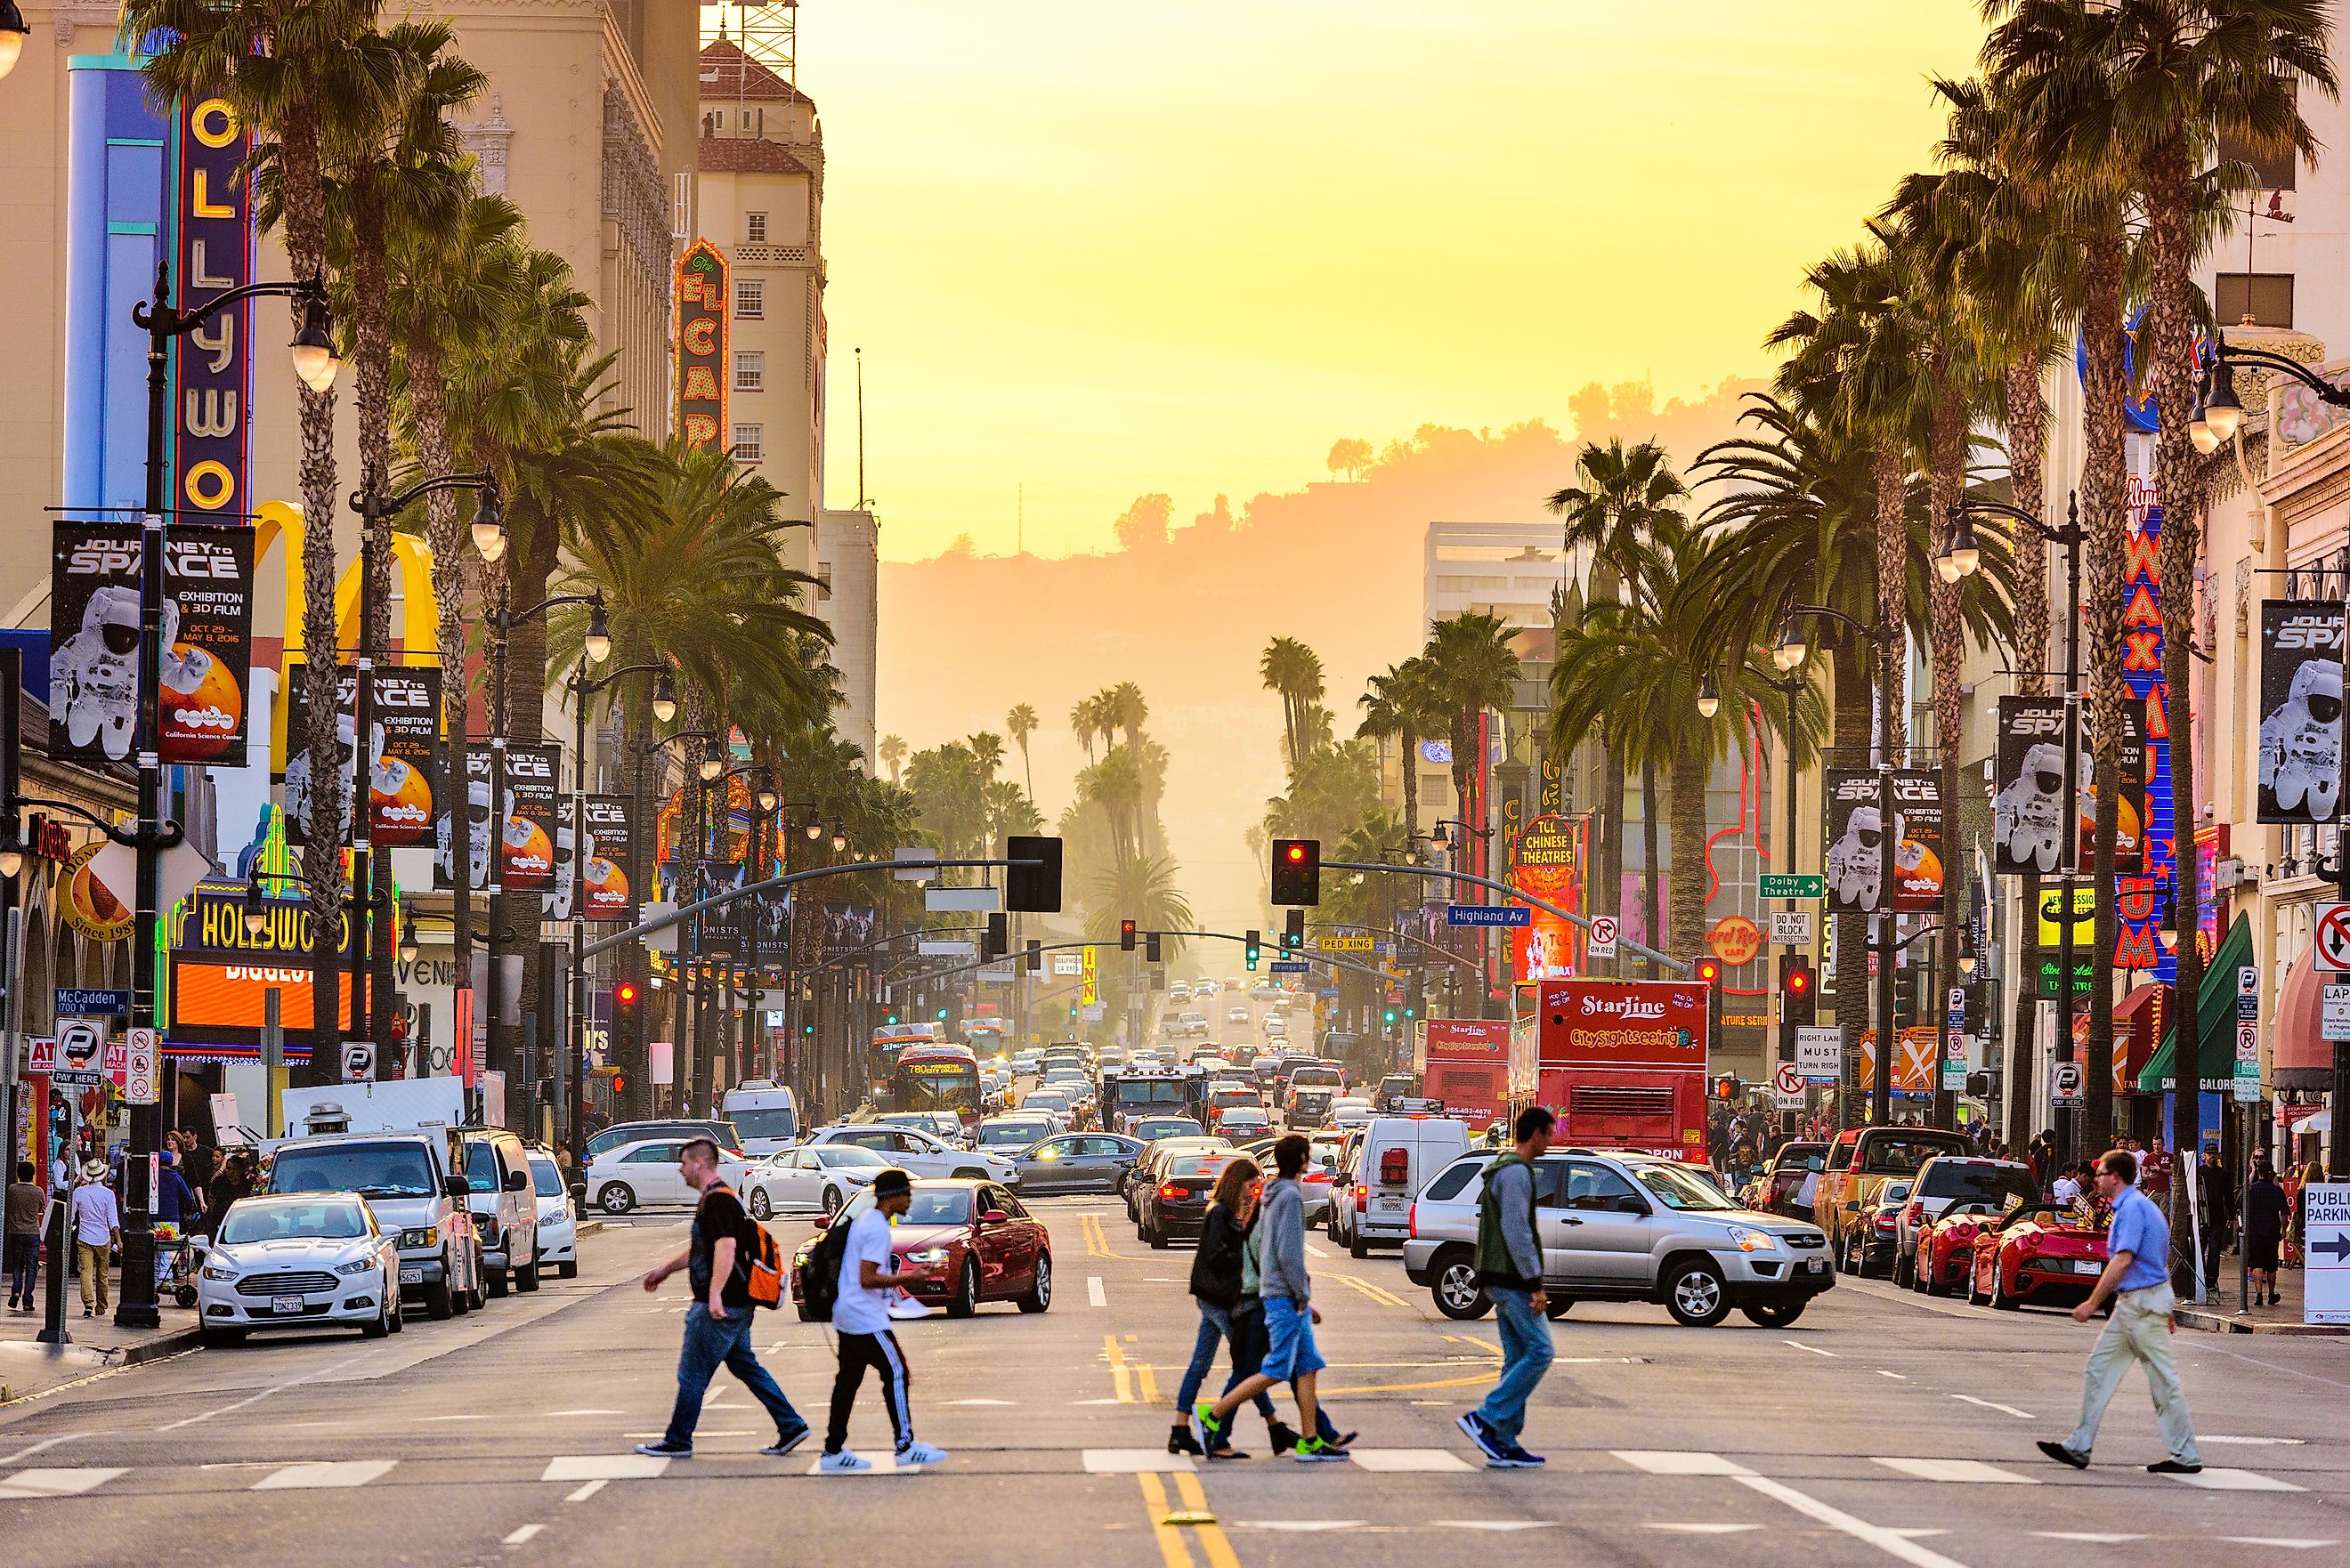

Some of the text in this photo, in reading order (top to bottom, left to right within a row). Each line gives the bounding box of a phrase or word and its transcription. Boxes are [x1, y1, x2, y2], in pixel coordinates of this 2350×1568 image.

[692, 256, 715, 272] The
[682, 273, 723, 311] EL
[179, 591, 243, 603] EXHIBITION
[2123, 528, 2163, 673] WAX
[181, 603, 241, 616] & 3D FILM
[2281, 616, 2345, 626] JOUR
[212, 626, 225, 634] 29
[183, 633, 202, 642] MAY
[217, 634, 239, 643] 2016
[2014, 709, 2092, 718] JOURN
[384, 716, 434, 725] EXHIBITION
[410, 727, 432, 735] FILM
[514, 784, 554, 792] EXHIBITION
[1537, 821, 1556, 834] TCL
[1526, 836, 1568, 848] CHINESE
[1522, 851, 1571, 863] THEATRES
[1770, 877, 1798, 889] Dolby
[1763, 887, 1804, 896] Theatre
[2073, 895, 2094, 904] ESSIO
[1455, 909, 1524, 924] Highland Av
[1776, 915, 1805, 924] DO NOT
[71, 917, 105, 939] Since
[1778, 925, 1803, 934] BLOCK
[1705, 926, 1735, 942] ard
[1325, 939, 1370, 949] PED XING
[1591, 945, 1613, 954] ON RED
[1724, 948, 1745, 957] CAFE
[1083, 951, 1095, 998] INN
[58, 990, 116, 1005] McCadden
[2325, 988, 2350, 999] LAP
[58, 1003, 76, 1013] 1700
[80, 1004, 85, 1013] N
[717, 1014, 726, 1049] ZARA
[31, 1042, 126, 1061] AT AT
[1803, 1047, 1838, 1057] MUST
[908, 1064, 927, 1074] 780
[56, 1074, 99, 1085] PAY HERE
[2161, 1077, 2176, 1089] CAM
[2199, 1078, 2235, 1091] GALORE
[1779, 1096, 1804, 1105] ON RED
[2160, 1156, 2170, 1165] 22
[2307, 1192, 2350, 1206] PUBLI
[2307, 1208, 2350, 1222] PARKIN
